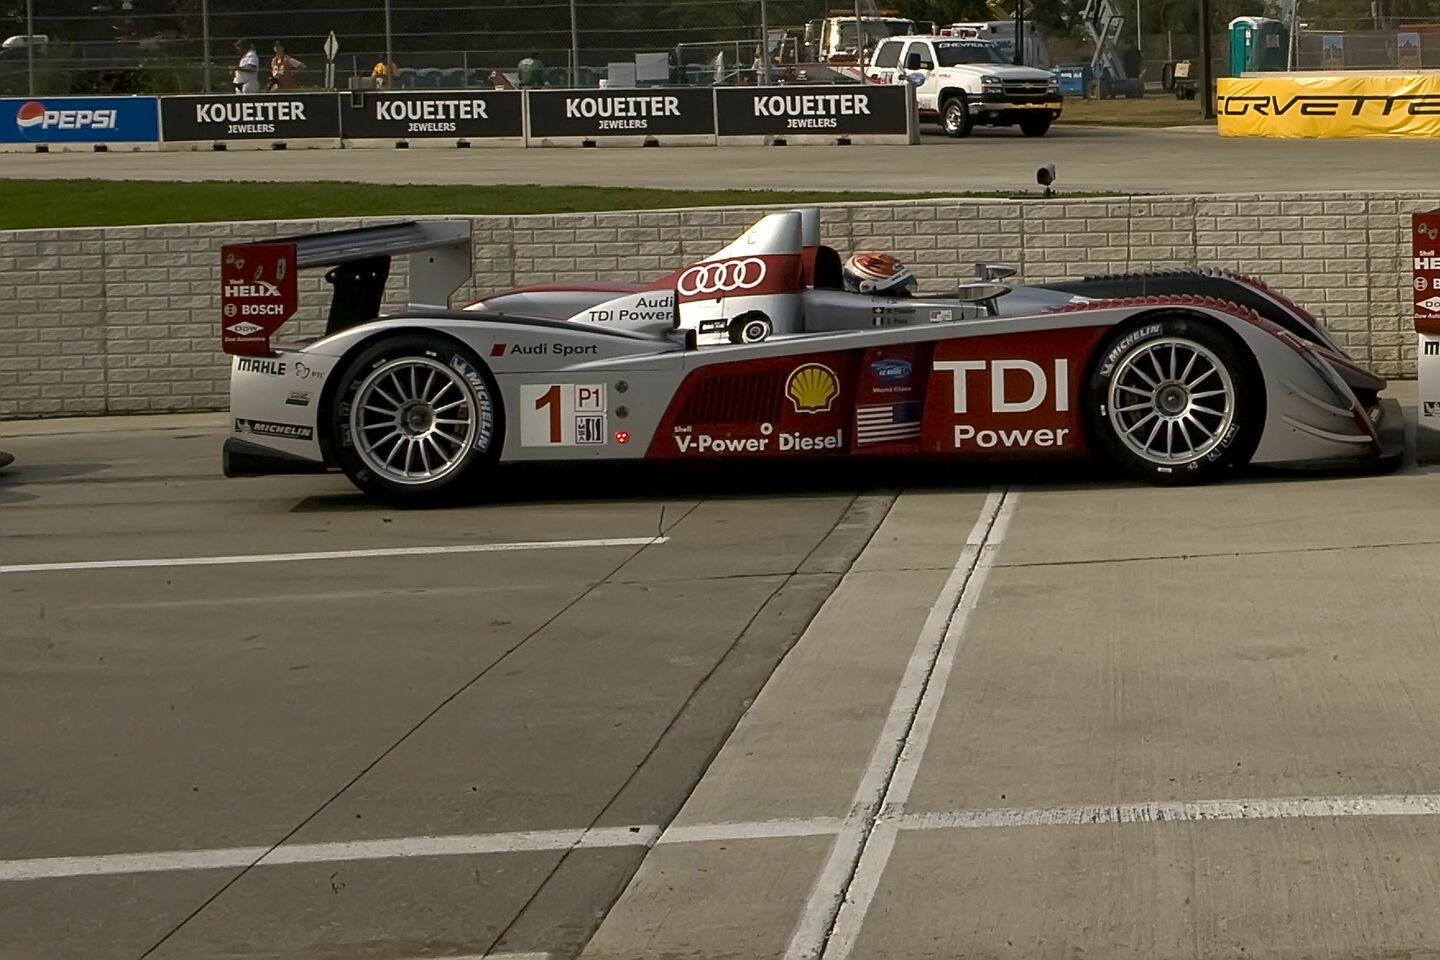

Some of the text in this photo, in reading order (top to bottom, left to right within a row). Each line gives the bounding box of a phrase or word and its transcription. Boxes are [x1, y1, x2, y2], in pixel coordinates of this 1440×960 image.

[196, 102, 306, 122] KOUEITER
[376, 100, 489, 121] KOUEITER
[565, 96, 681, 118] KOUEITER
[753, 94, 871, 116] KOUEITER
[42, 109, 117, 130] PEPSI
[408, 122, 457, 132] JEWELERS
[598, 119, 648, 130] JEWELERS
[787, 118, 837, 129] JEWELERS
[228, 124, 275, 134] JEWELERS
[224, 283, 281, 297] HELIX
[242, 304, 284, 315] BOSCH
[636, 296, 673, 308] Audi
[589, 310, 673, 321] TDI Power
[510, 344, 598, 357] Audi Sport
[1108, 324, 1160, 360] MICHELIN
[238, 358, 287, 375] MAHLE
[932, 358, 1070, 413] TDI
[578, 388, 600, 408] P1
[466, 372, 492, 450] MICHELIN
[534, 384, 562, 442] 1
[253, 423, 312, 437] MICHELIN
[674, 425, 692, 433] Shell
[954, 423, 1070, 449] Power
[674, 429, 843, 452] V-Power Diesel
